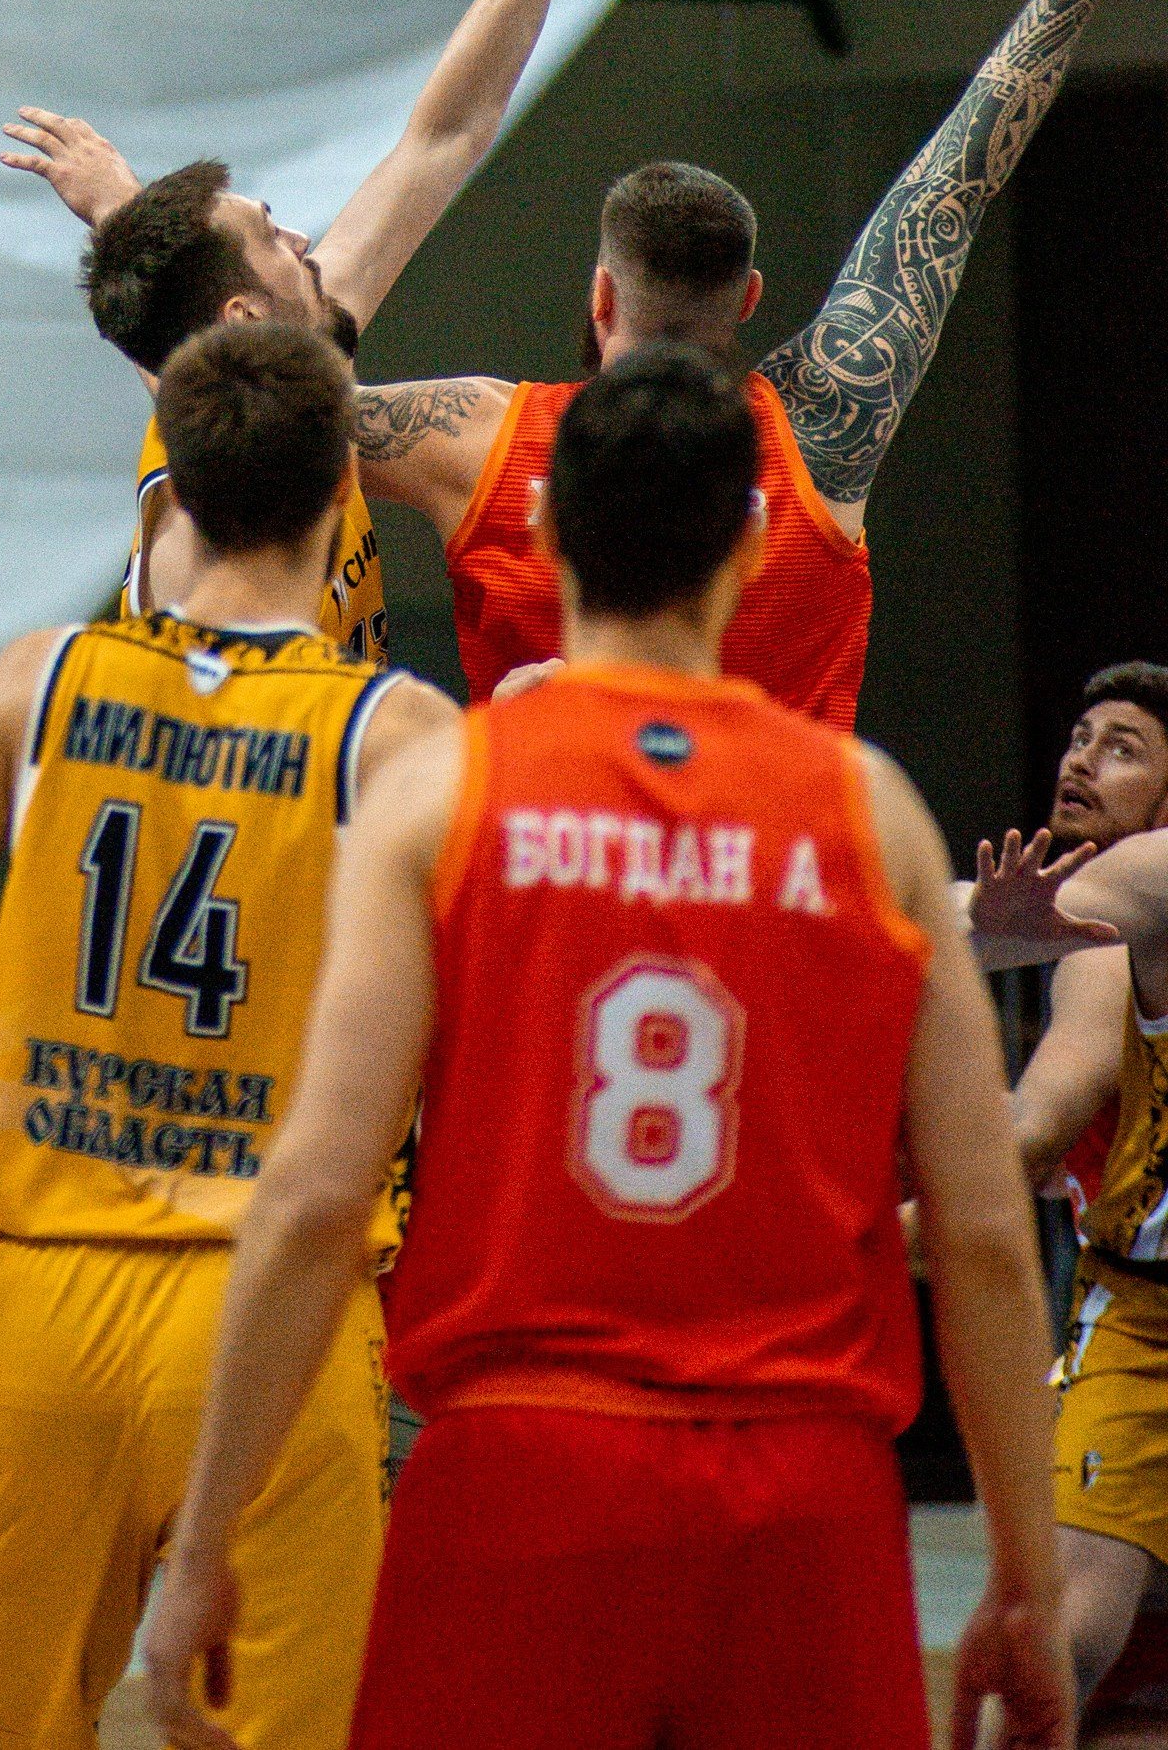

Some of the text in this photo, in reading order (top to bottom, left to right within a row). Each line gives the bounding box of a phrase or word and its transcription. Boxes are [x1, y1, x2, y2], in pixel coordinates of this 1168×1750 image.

[64, 697, 311, 798] МИЛЮТИН
[502, 809, 755, 905] БОГДАН
[76, 798, 248, 1039] 14
[23, 1038, 275, 1124] КУРСКАЯ
[566, 953, 745, 1225] 8
[24, 1098, 263, 1179] ОБЛАСТЬ
